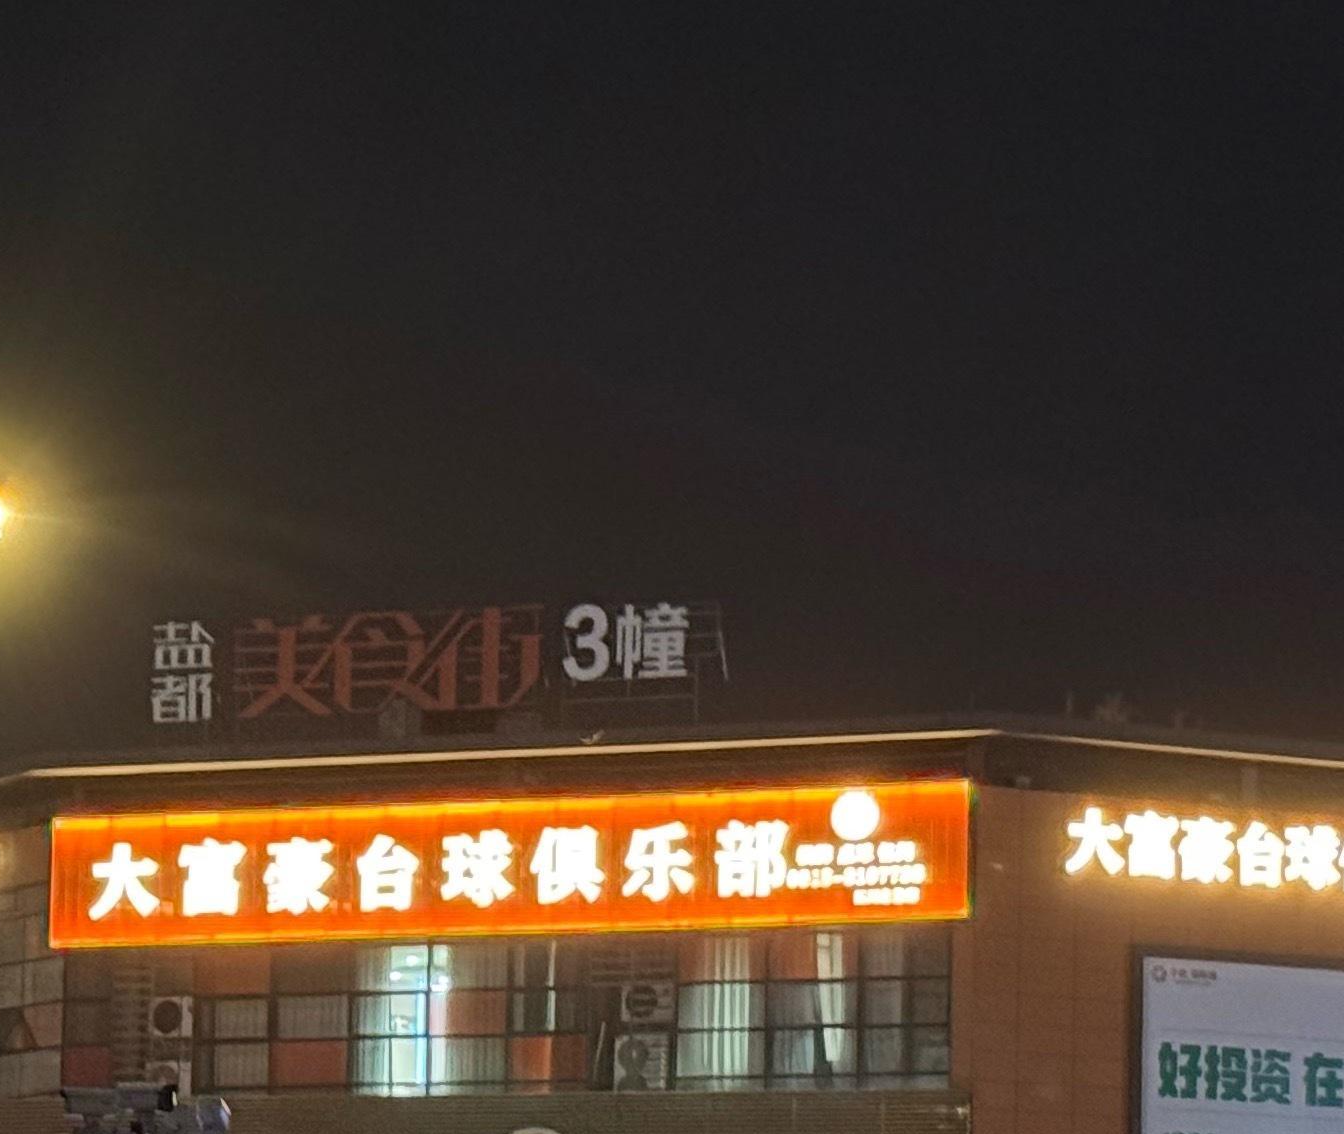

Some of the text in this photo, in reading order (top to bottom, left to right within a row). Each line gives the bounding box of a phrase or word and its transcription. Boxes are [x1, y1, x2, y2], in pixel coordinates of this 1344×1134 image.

[151, 602, 690, 722] 盐都 美食街 3幢
[88, 819, 789, 920] 大富豪台球俱乐部
[1158, 1041, 1291, 1105] 好投资
